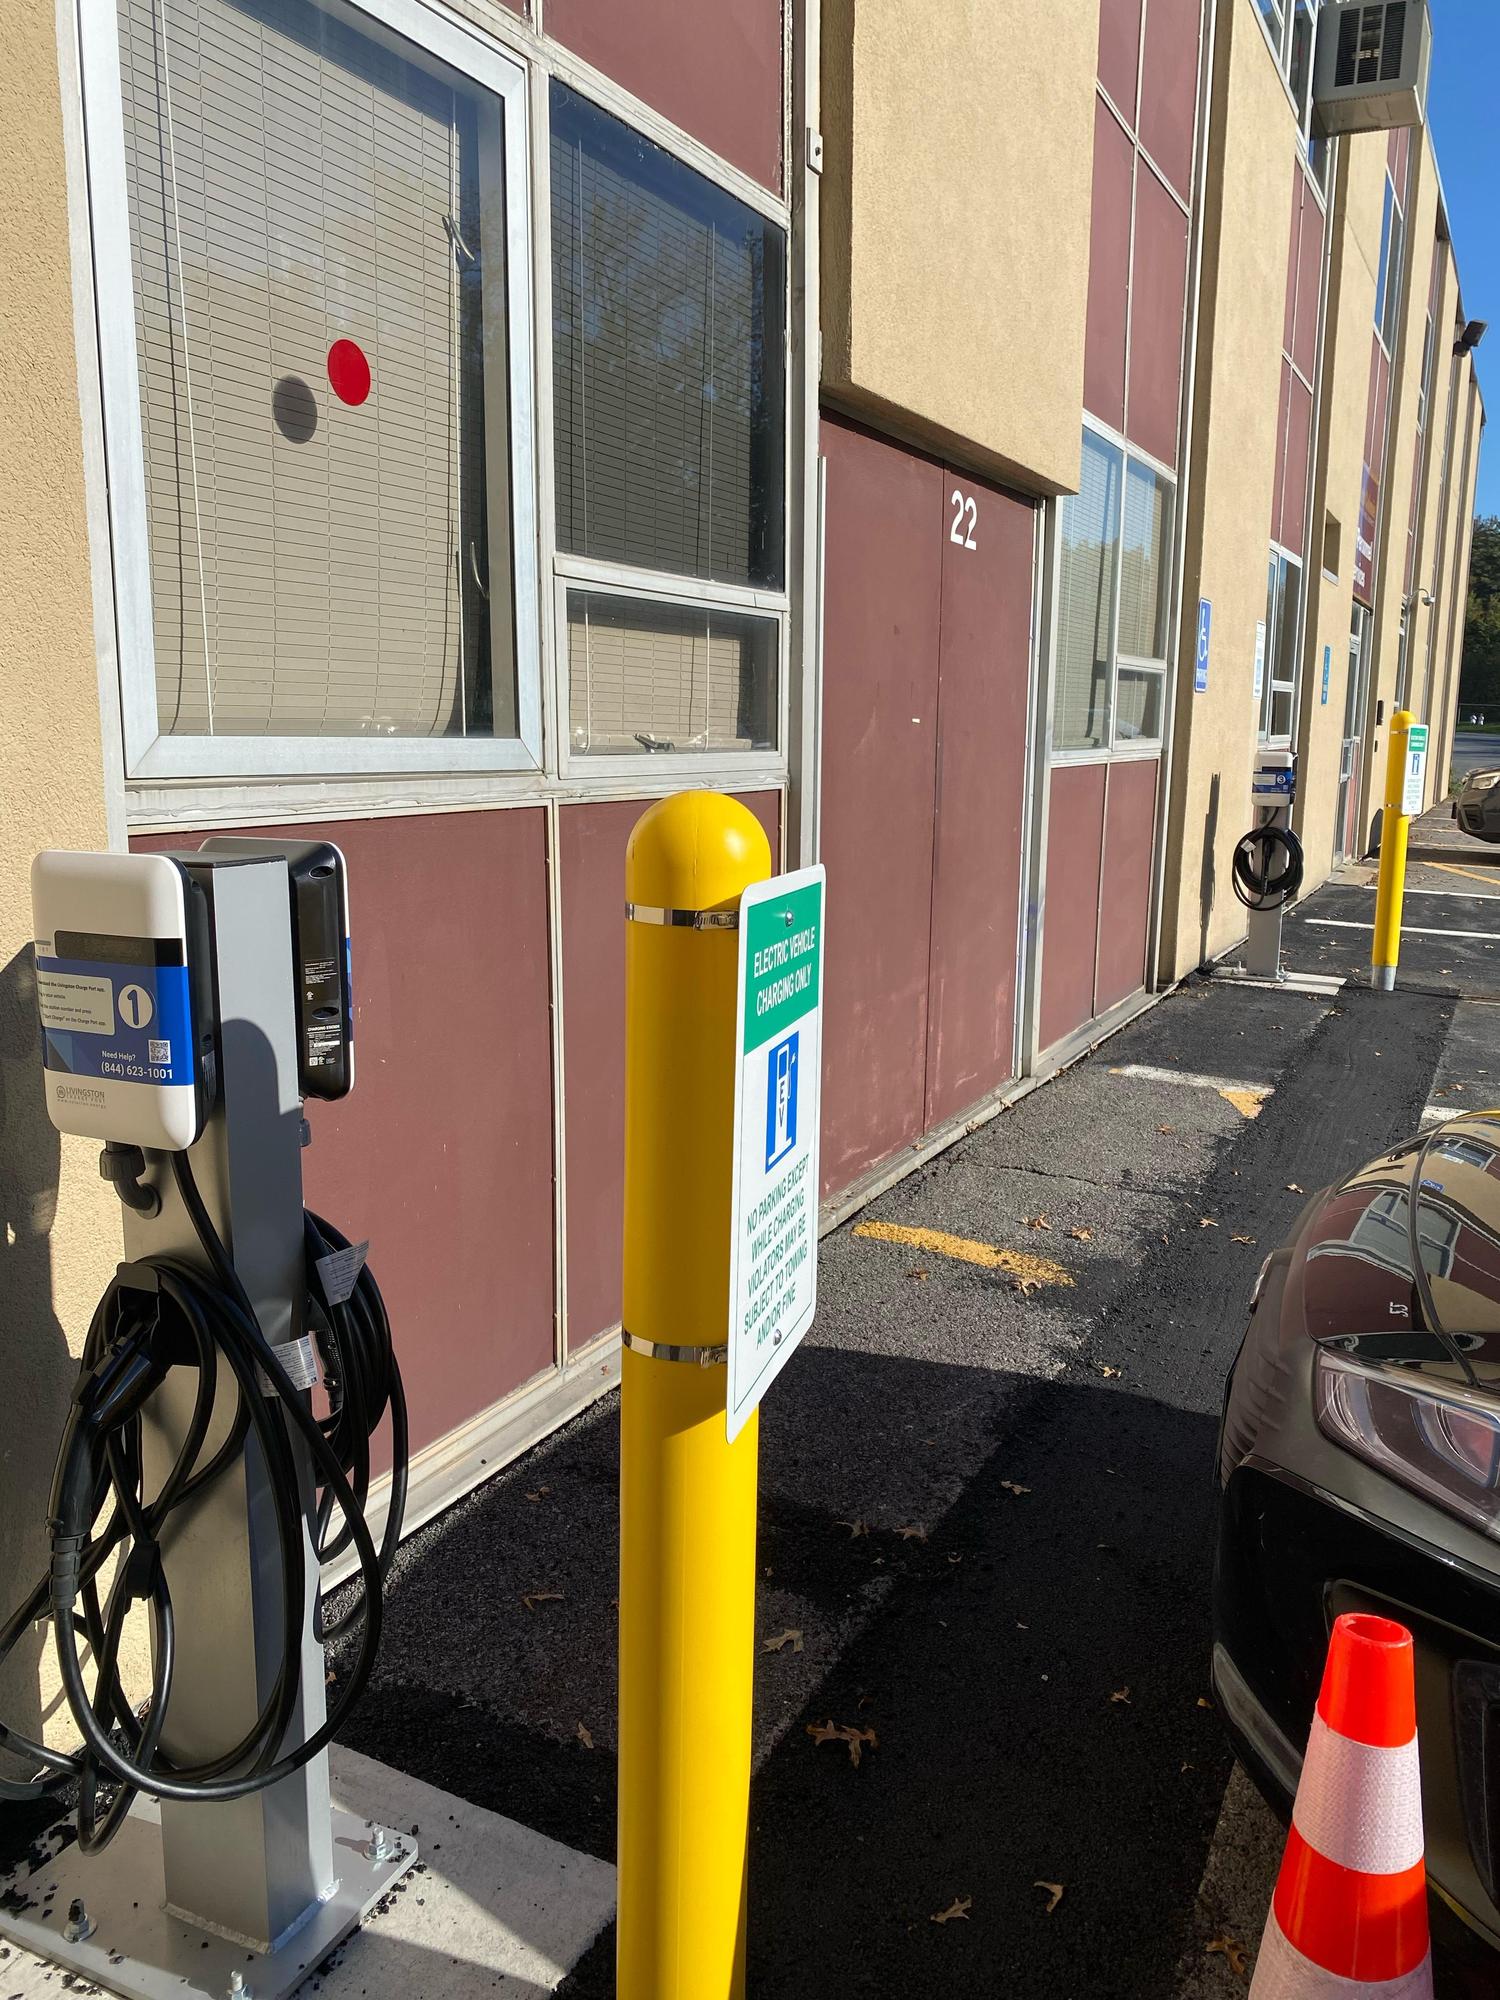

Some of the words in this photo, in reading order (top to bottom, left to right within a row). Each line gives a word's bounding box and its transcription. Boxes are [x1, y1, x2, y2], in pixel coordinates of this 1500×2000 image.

[950, 490, 977, 551] 22
[754, 938, 788, 978] ELECTRIC
[789, 926, 816, 960] VEHICLE
[127, 990, 139, 1025] 1
[756, 973, 794, 1016] CHARGING
[795, 962, 812, 993] ONLY
[101, 1061, 124, 1076] (844)
[127, 1066, 173, 1079] 623-1001
[102, 1050, 117, 1059] Need
[119, 1052, 136, 1062] Help?
[66, 1086, 104, 1098] LIVINGSTON
[779, 1080, 785, 1127] EV
[746, 1208, 757, 1237] NO
[759, 1178, 786, 1224] PARKING
[788, 1153, 809, 1192] EXCEPT
[752, 1222, 772, 1263] WHILE
[774, 1187, 804, 1237] CHARGING
[748, 1240, 783, 1298] VIOLATORS
[785, 1222, 797, 1254] MAY
[798, 1212, 806, 1238] BE
[744, 1280, 774, 1335] SUBJECT
[776, 1269, 783, 1294] TO
[785, 1240, 807, 1282] TOWING
[782, 1281, 796, 1314] FINE
